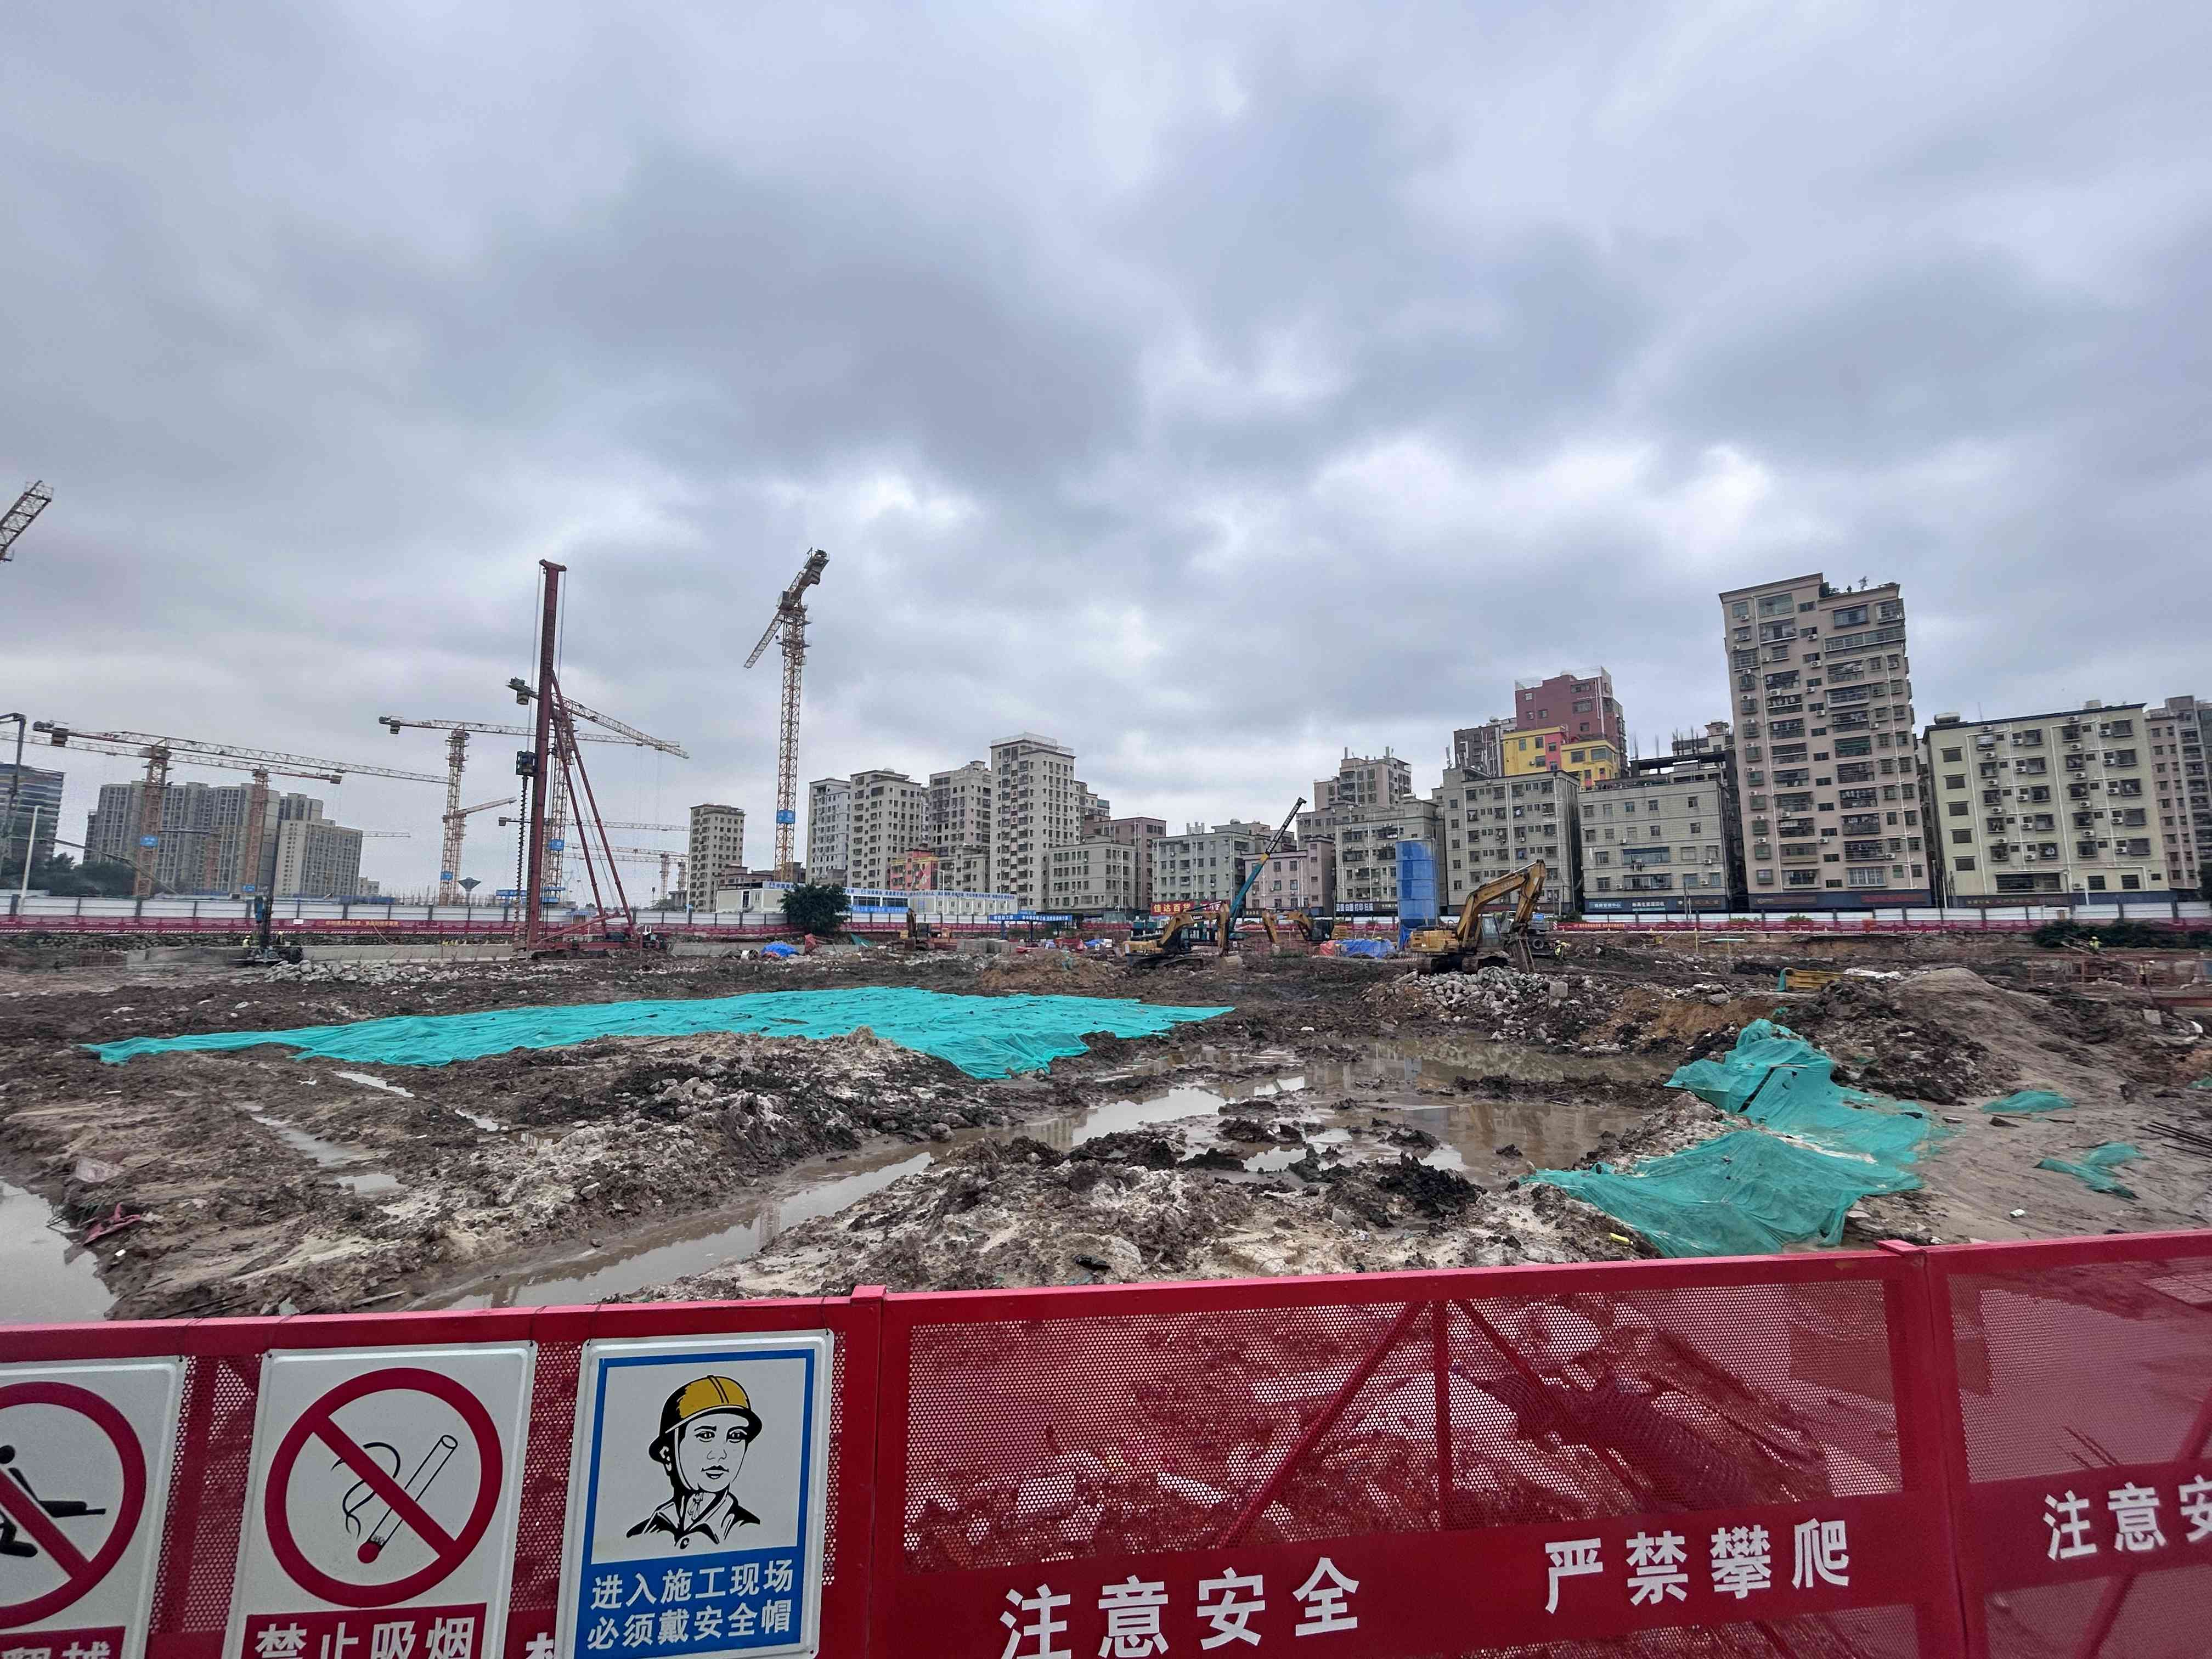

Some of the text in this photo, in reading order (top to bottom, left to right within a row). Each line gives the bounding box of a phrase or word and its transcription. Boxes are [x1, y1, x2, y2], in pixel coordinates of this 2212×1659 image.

[590, 1559, 793, 1610] 进入施工现场
[1000, 1518, 1849, 1659] 注意安全 严禁攀爬
[255, 1616, 475, 1659] 禁止吸烟
[587, 1599, 792, 1650] 必须戴安全帽
